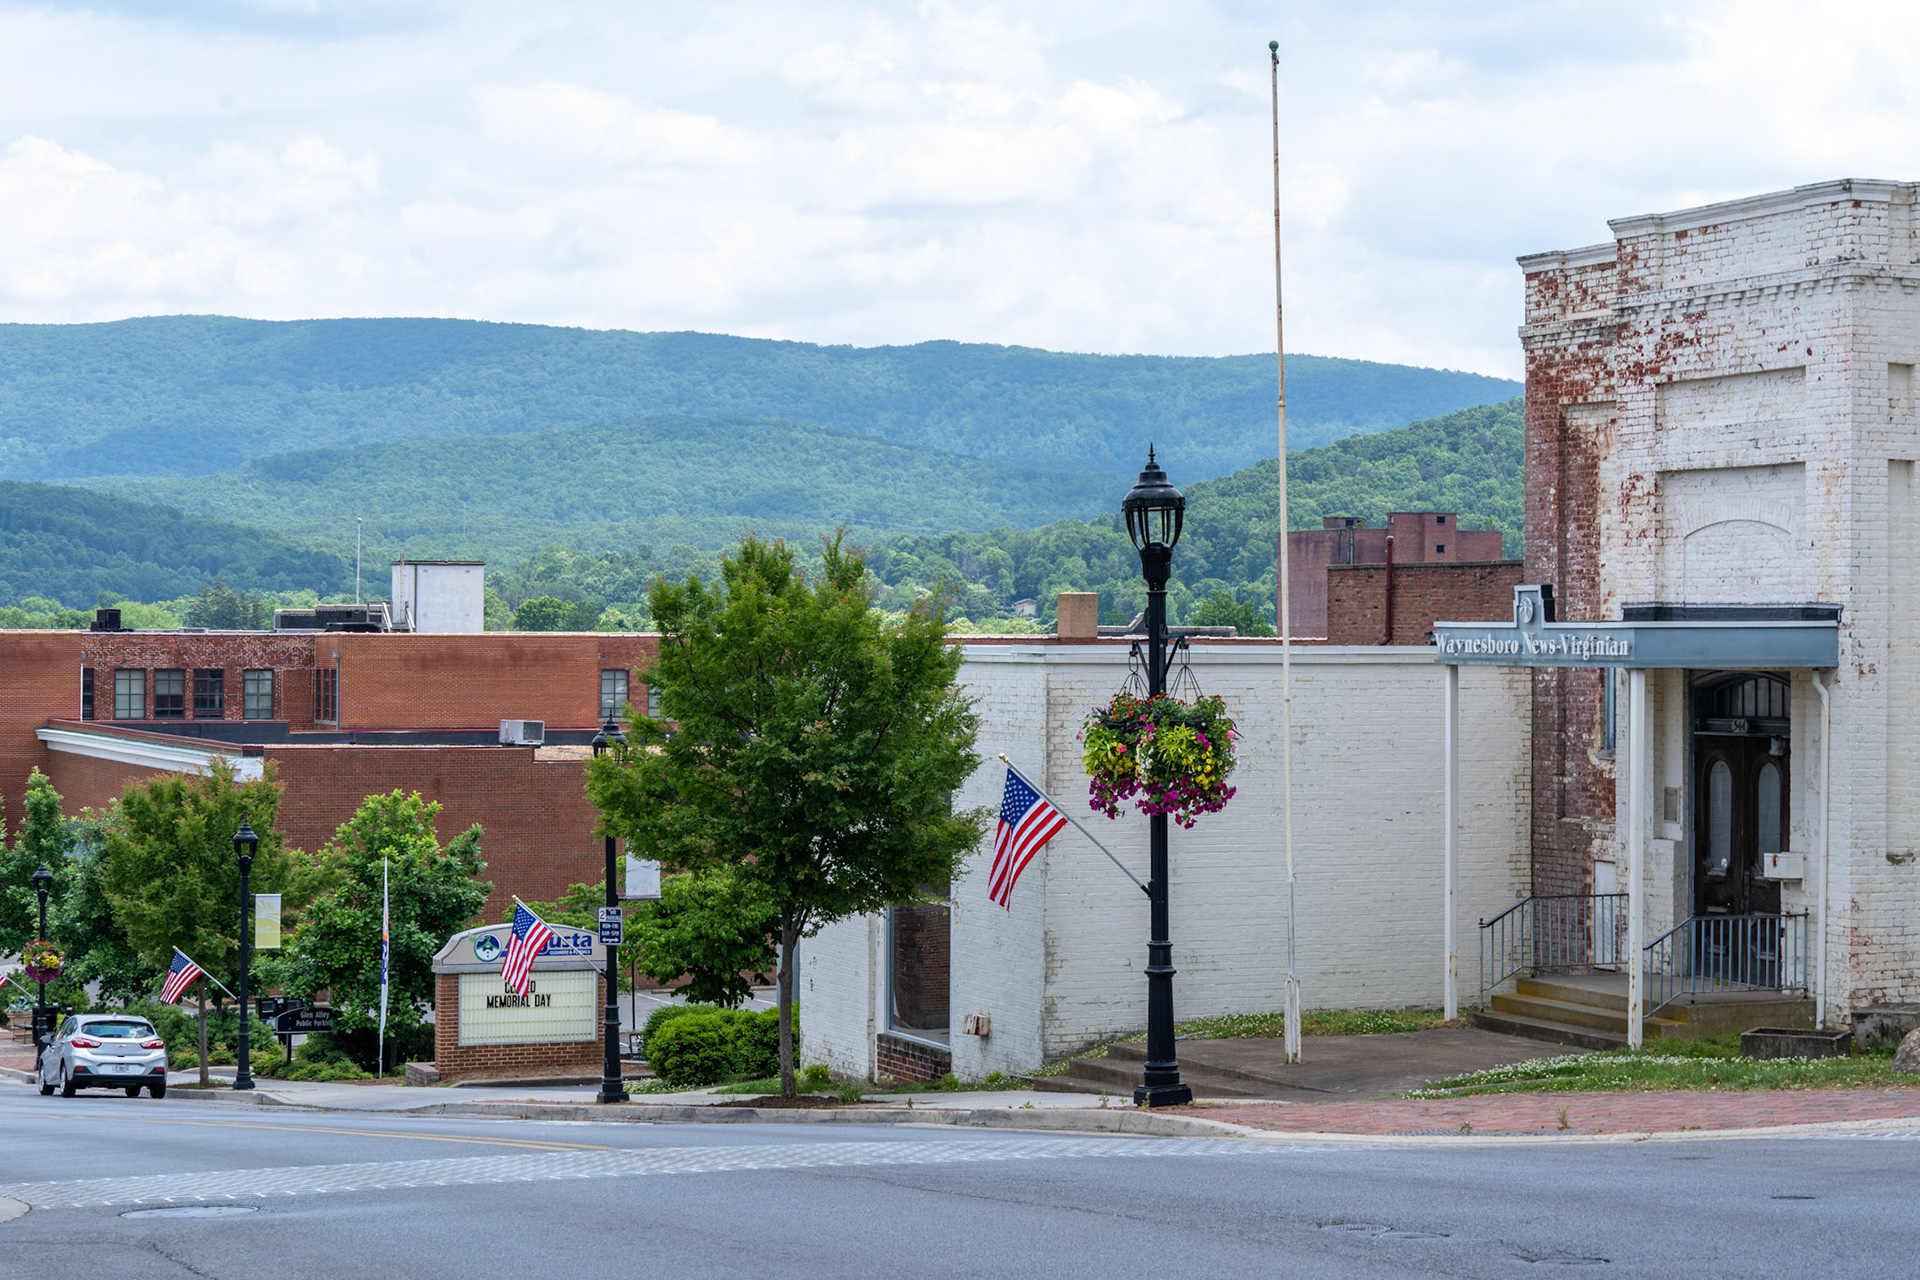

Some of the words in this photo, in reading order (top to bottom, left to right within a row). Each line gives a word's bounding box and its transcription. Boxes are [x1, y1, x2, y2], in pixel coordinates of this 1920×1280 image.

[1435, 632, 1519, 656] Waynesboro
[1522, 631, 1629, 661] News-Virginian
[1733, 720, 1746, 730] 544
[600, 910, 605, 920] 2
[486, 995, 530, 1008] MEMORIAL
[534, 994, 551, 1007] DAY
[300, 1011, 313, 1019] Glen
[315, 1011, 330, 1019] Alley
